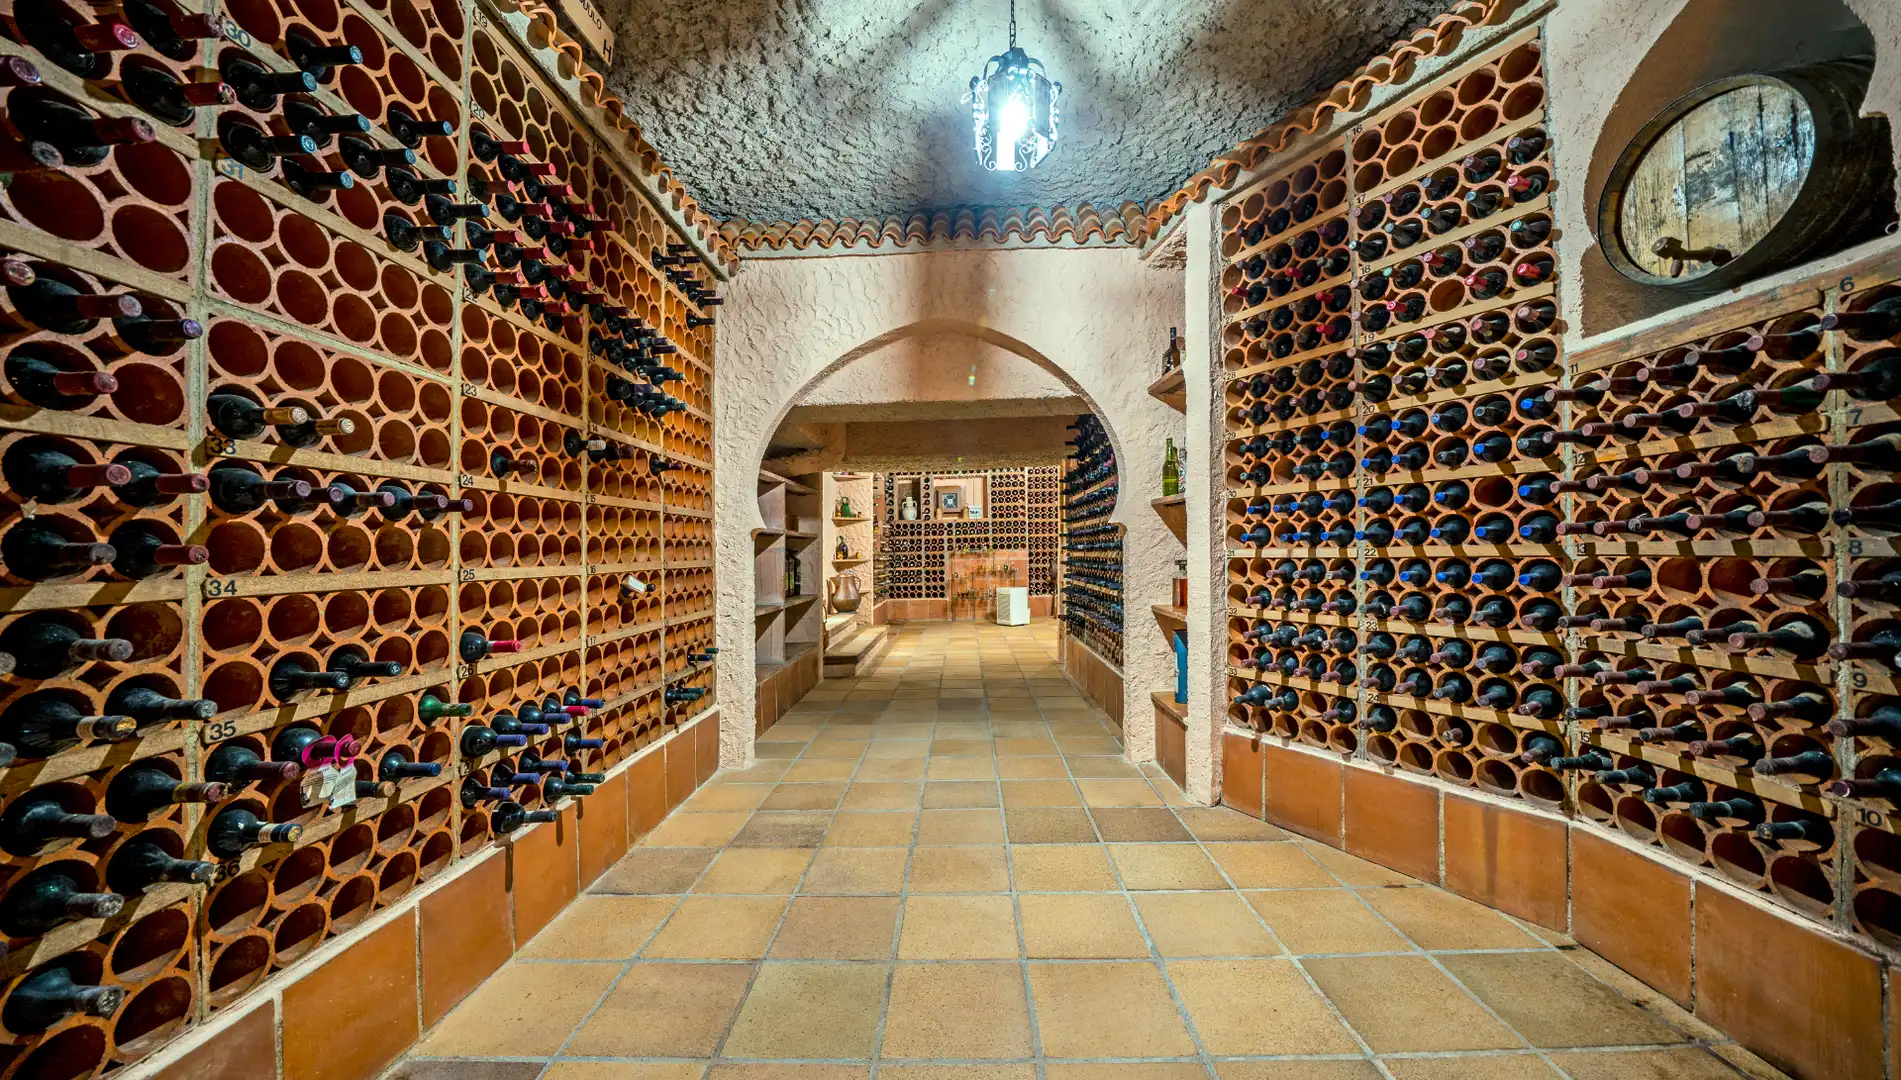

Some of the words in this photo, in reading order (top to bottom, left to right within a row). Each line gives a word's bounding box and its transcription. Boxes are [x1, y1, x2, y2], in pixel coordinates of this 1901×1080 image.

[478, 11, 488, 28] 19
[579, 0, 602, 30] DULO
[226, 20, 251, 48] 30
[603, 39, 612, 62] H
[472, 103, 485, 120] 20
[1352, 125, 1363, 135] 16
[222, 158, 243, 180] 31
[1356, 193, 1366, 204] 17
[1361, 264, 1371, 275] 18
[1840, 275, 1855, 292] 6
[1363, 333, 1374, 343] 19
[1570, 363, 1579, 374] 11
[1225, 372, 1236, 381] 28
[464, 383, 477, 397] 23
[1363, 405, 1375, 415] 20
[1850, 408, 1863, 425] 7
[592, 424, 598, 433] 14
[210, 437, 236, 455] 33
[1575, 453, 1585, 464] 12
[462, 474, 475, 487] 24
[1363, 477, 1374, 487] 21
[1364, 547, 1376, 557] 22
[1848, 540, 1862, 556] 8
[463, 569, 475, 581] 25
[208, 579, 238, 597] 34
[1228, 608, 1238, 616] 32
[1365, 620, 1377, 630] 23
[461, 664, 474, 678] 26
[1229, 667, 1238, 676] 33
[1852, 671, 1867, 688] 9
[1367, 693, 1379, 703] 24
[210, 720, 237, 740] 35
[1580, 731, 1590, 743] 15
[1856, 808, 1882, 826] 10
